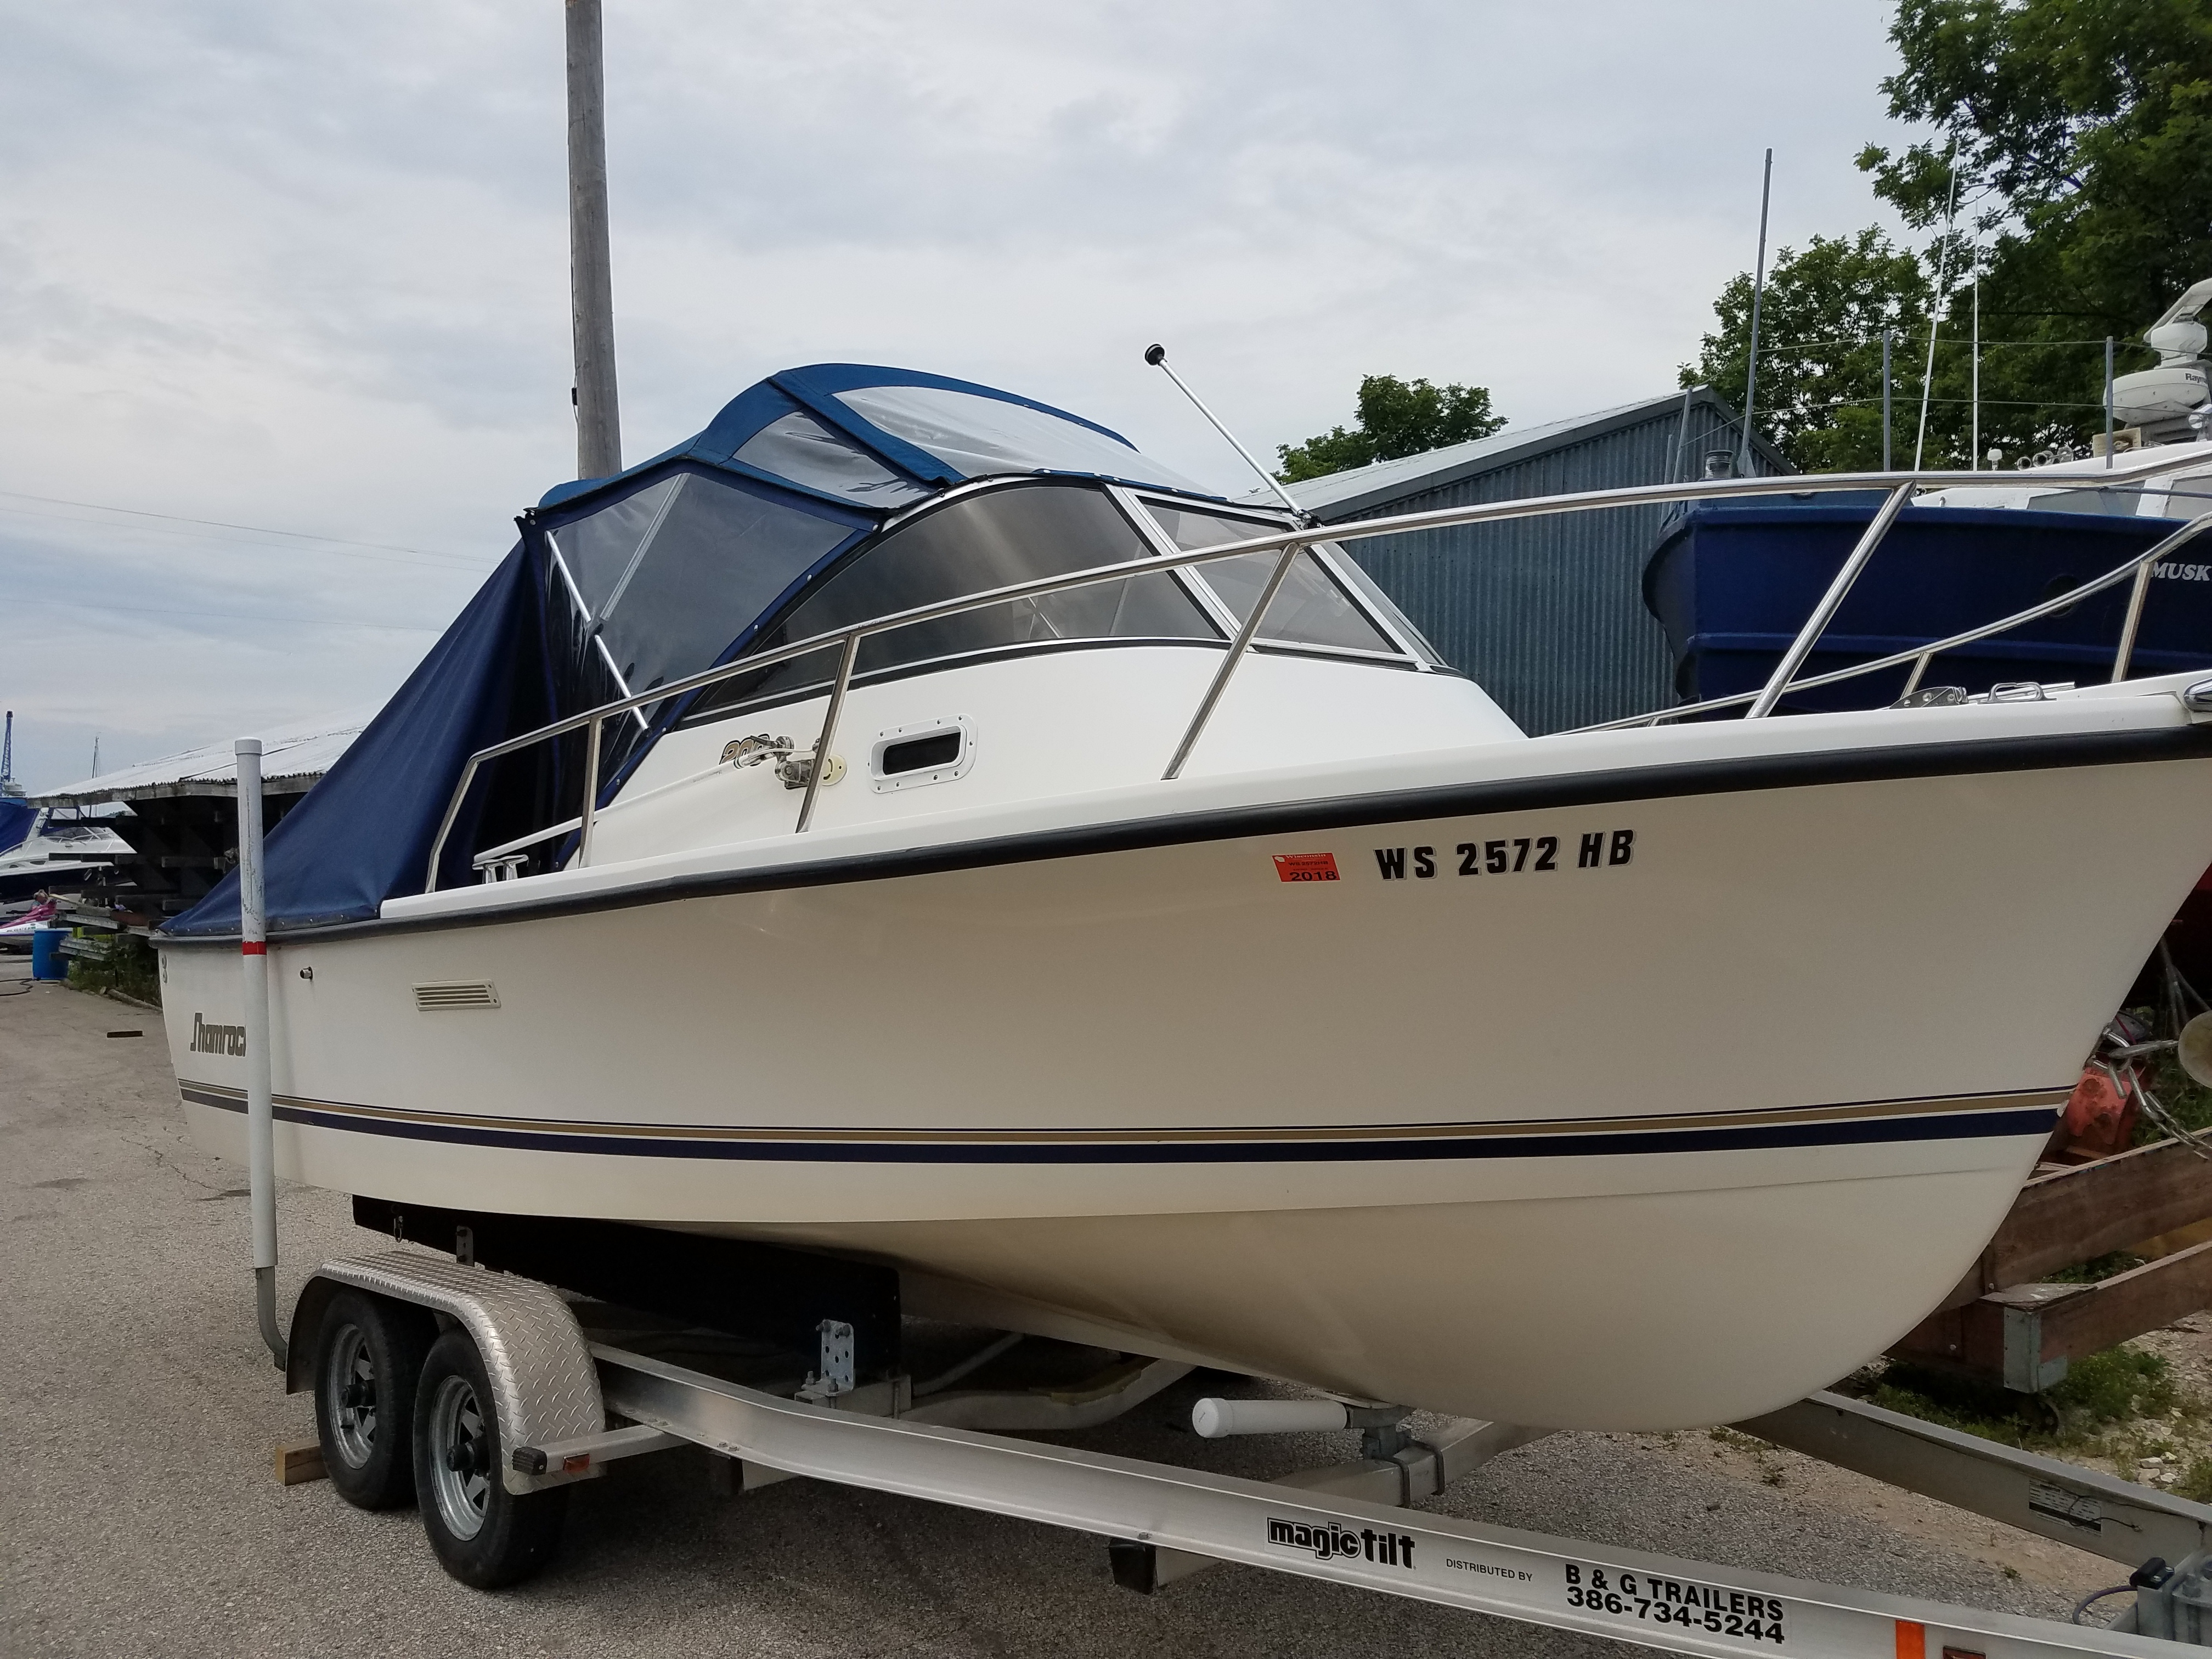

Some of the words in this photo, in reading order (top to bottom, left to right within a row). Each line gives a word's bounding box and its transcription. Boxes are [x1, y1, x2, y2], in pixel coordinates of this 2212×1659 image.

[2151, 562, 2212, 581] MUSK
[1289, 871, 1337, 881] 2018
[1373, 846, 1437, 881] WS
[1455, 836, 1560, 877] 2572
[1577, 829, 1635, 869] HB
[190, 1012, 246, 1057] Shamroc
[1446, 1558, 1516, 1579] DISTRIBUTED
[1518, 1571, 1533, 1582] BY
[1565, 1564, 1581, 1584] B
[1591, 1569, 1609, 1591] &
[1620, 1574, 1637, 1595] G
[1647, 1578, 1784, 1622] TRAILERS
[1566, 1586, 1785, 1644] 386-734-5244
